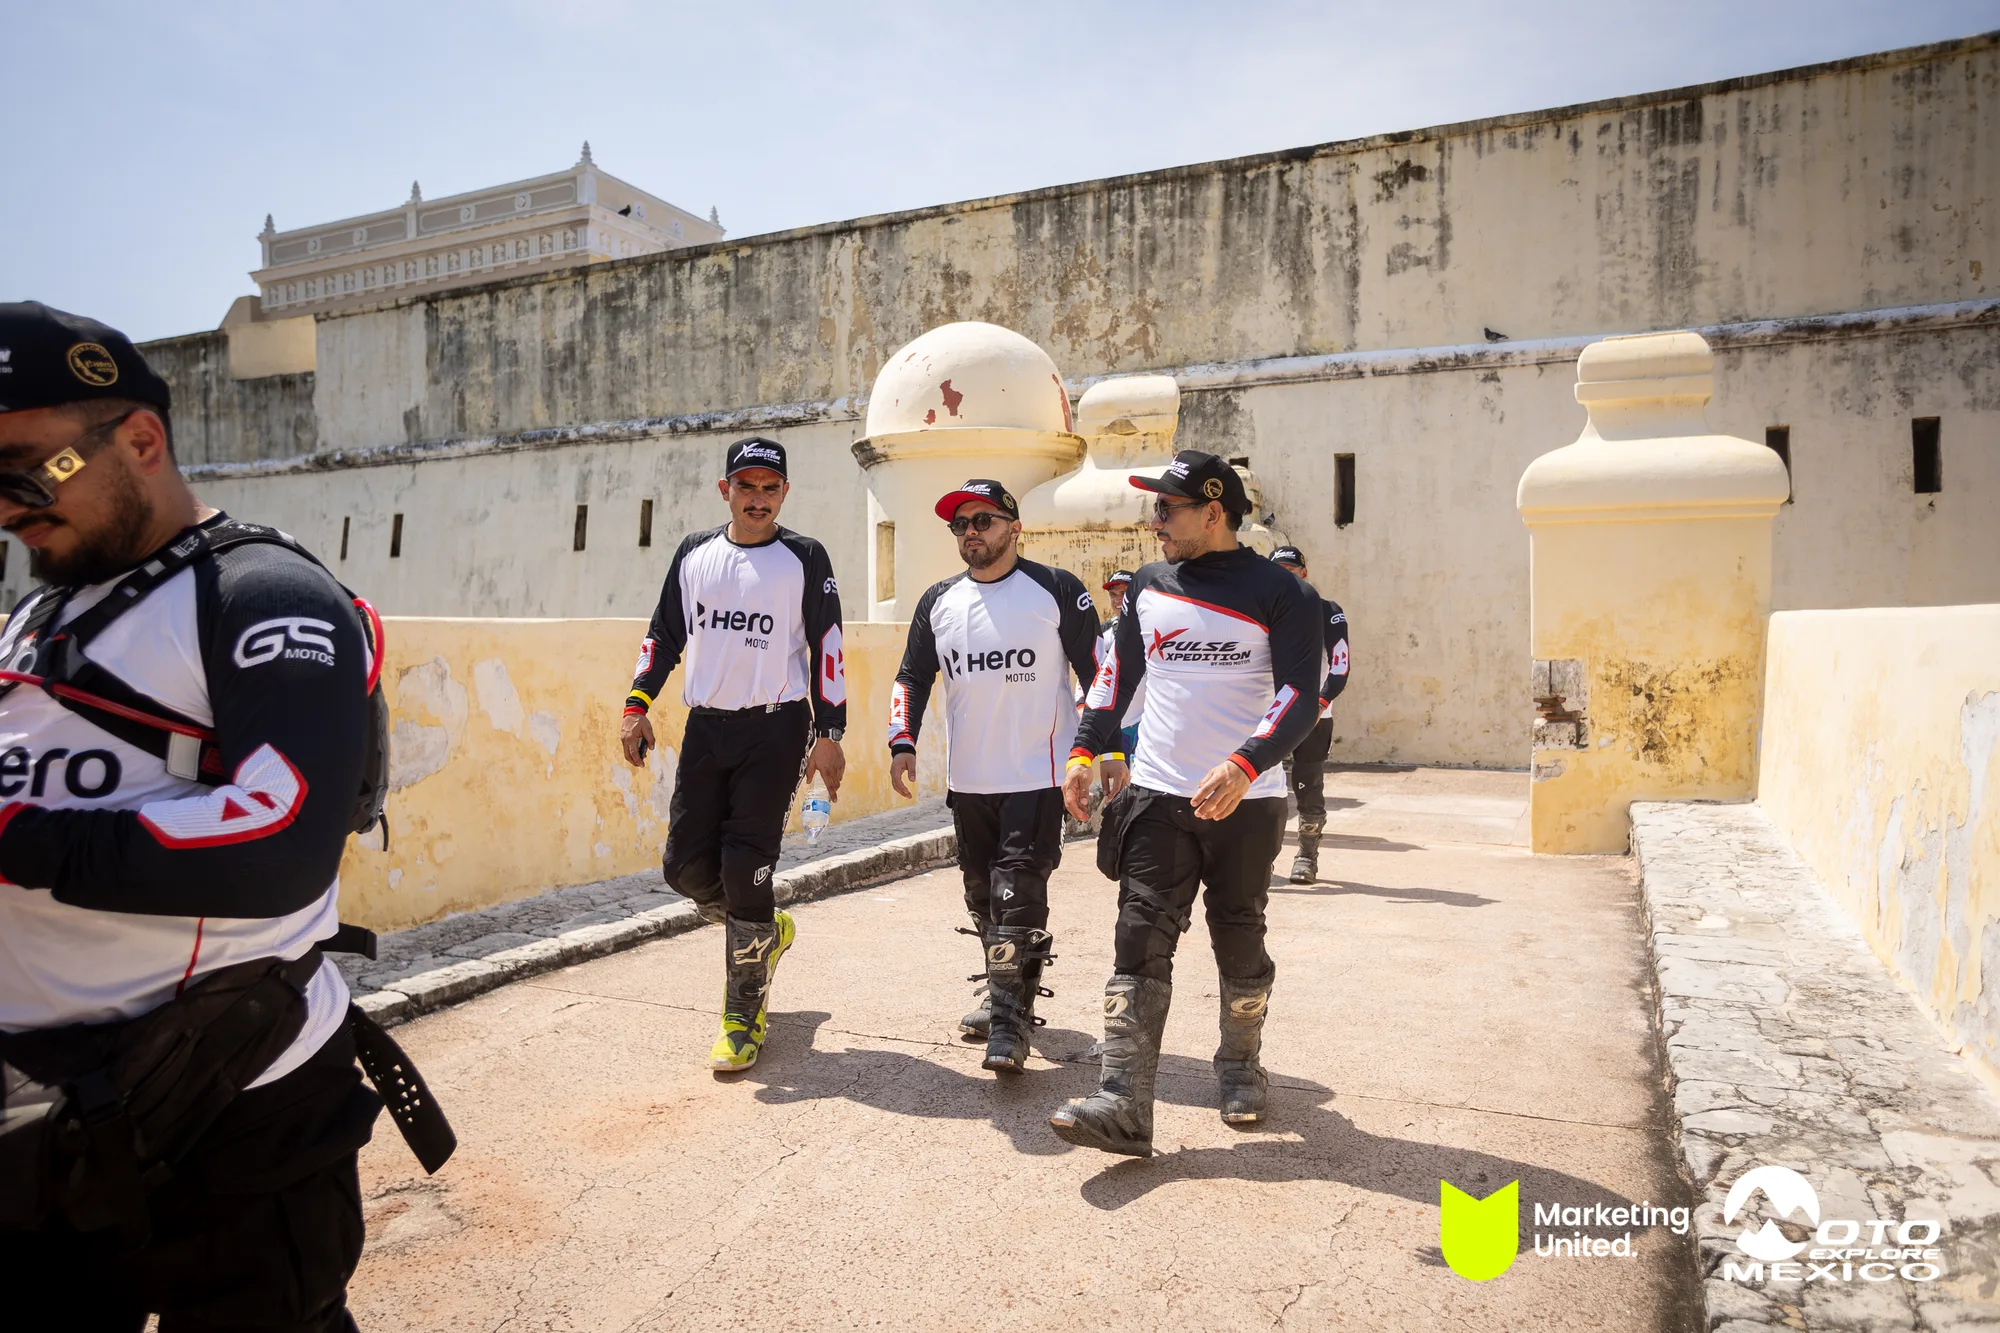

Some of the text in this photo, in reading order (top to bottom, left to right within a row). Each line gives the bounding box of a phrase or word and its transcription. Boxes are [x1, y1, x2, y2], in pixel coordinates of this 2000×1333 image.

[711, 609, 774, 635] Hero
[235, 617, 336, 668] GS
[744, 637, 769, 650] MOTOS
[284, 648, 335, 667] MOTOS
[967, 648, 1036, 673] Hero
[1165, 650, 1251, 661] XPEDITION
[1005, 672, 1036, 683] MOTOS
[0, 746, 123, 799] ero
